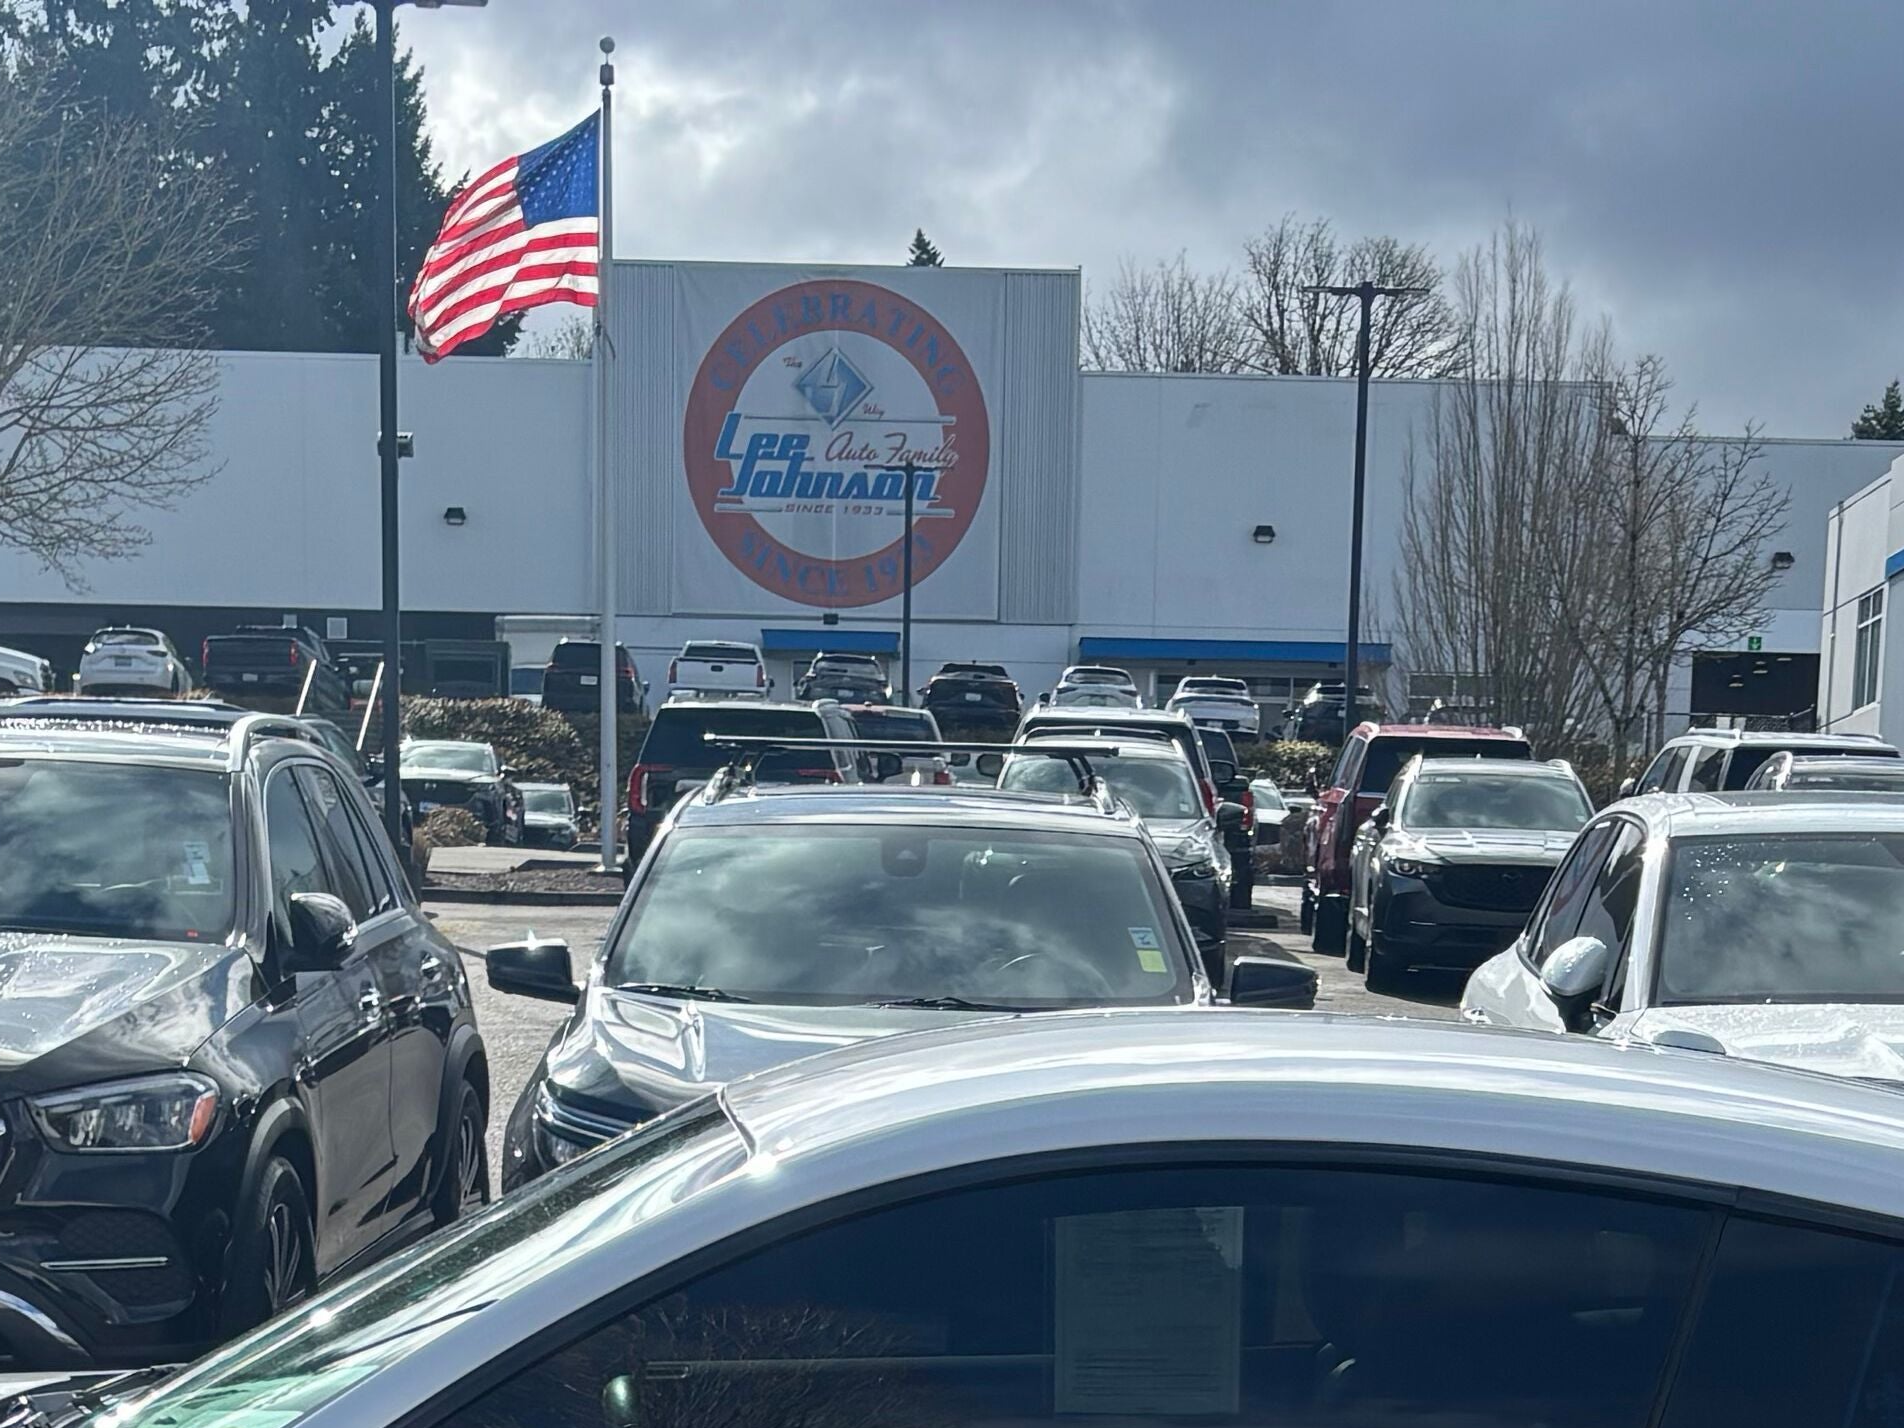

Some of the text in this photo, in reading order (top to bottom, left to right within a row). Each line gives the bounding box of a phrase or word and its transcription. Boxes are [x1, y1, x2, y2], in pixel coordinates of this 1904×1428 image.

[708, 291, 966, 395] CELEBRATING
[713, 412, 960, 474] Lee Auto Family
[717, 452, 942, 501] Johnson
[785, 503, 884, 516] SINCE 1933
